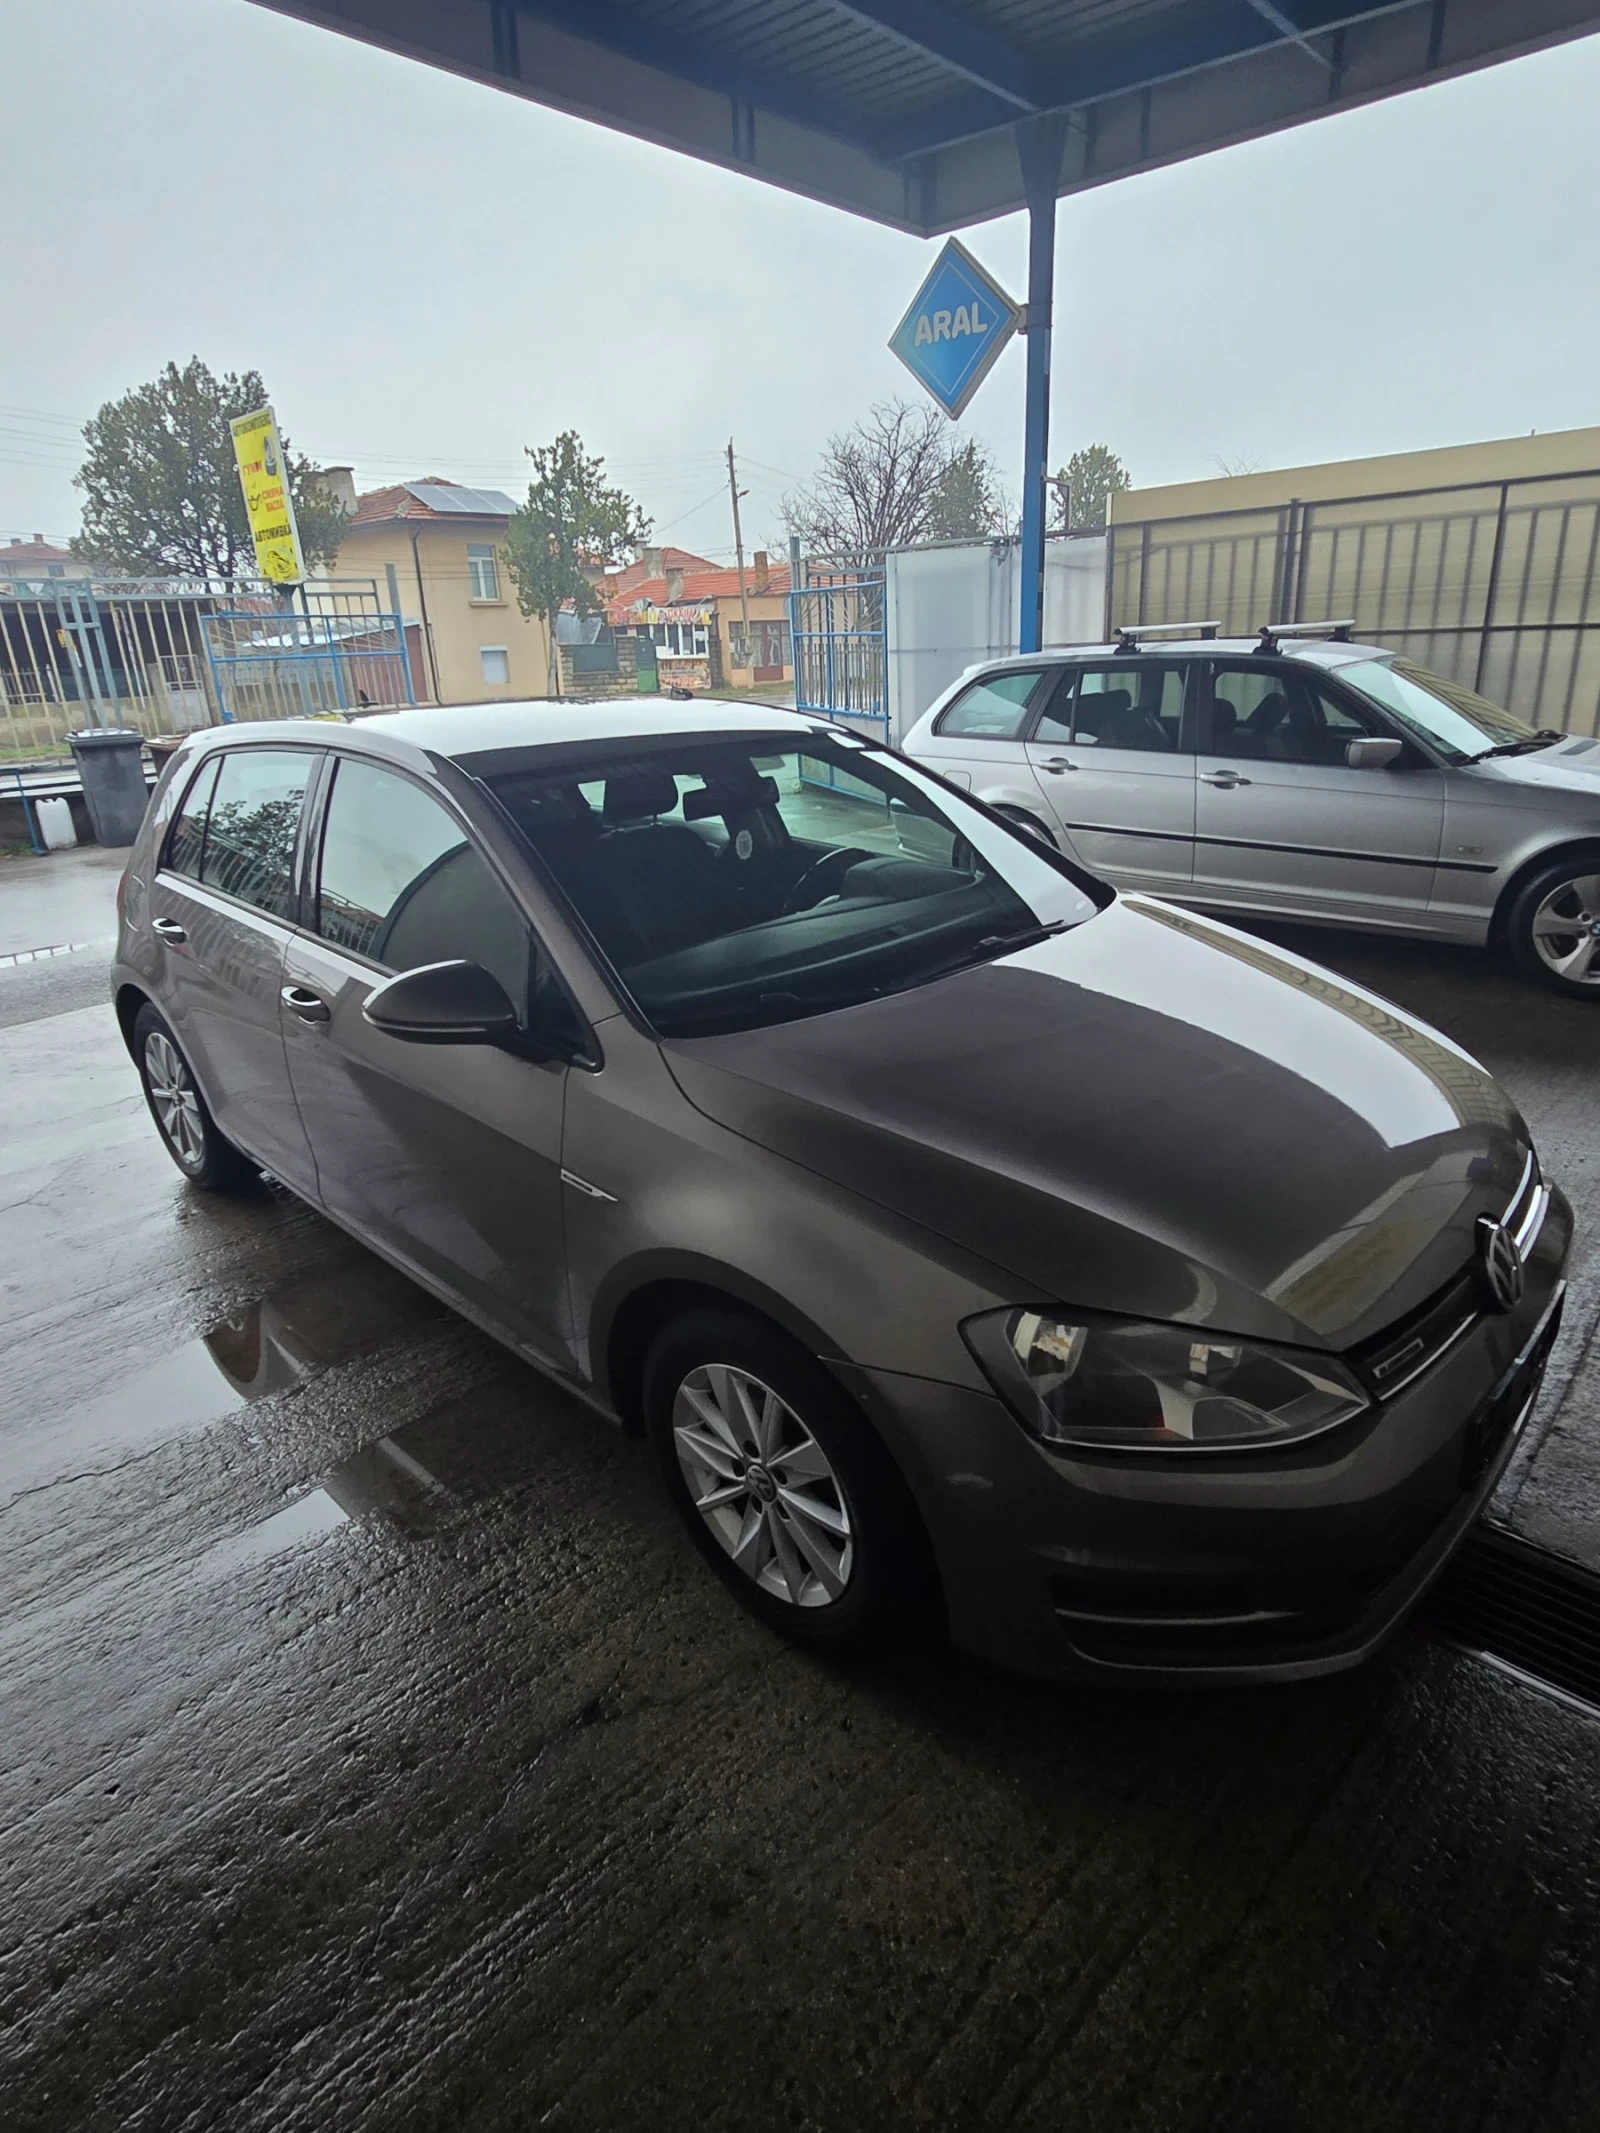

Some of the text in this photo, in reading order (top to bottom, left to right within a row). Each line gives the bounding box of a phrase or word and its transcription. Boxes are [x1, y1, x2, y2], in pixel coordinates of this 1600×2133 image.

[914, 302, 988, 347] ARAL
[242, 460, 263, 476] ГУМИ
[255, 523, 292, 542] АВТОМИВКА
